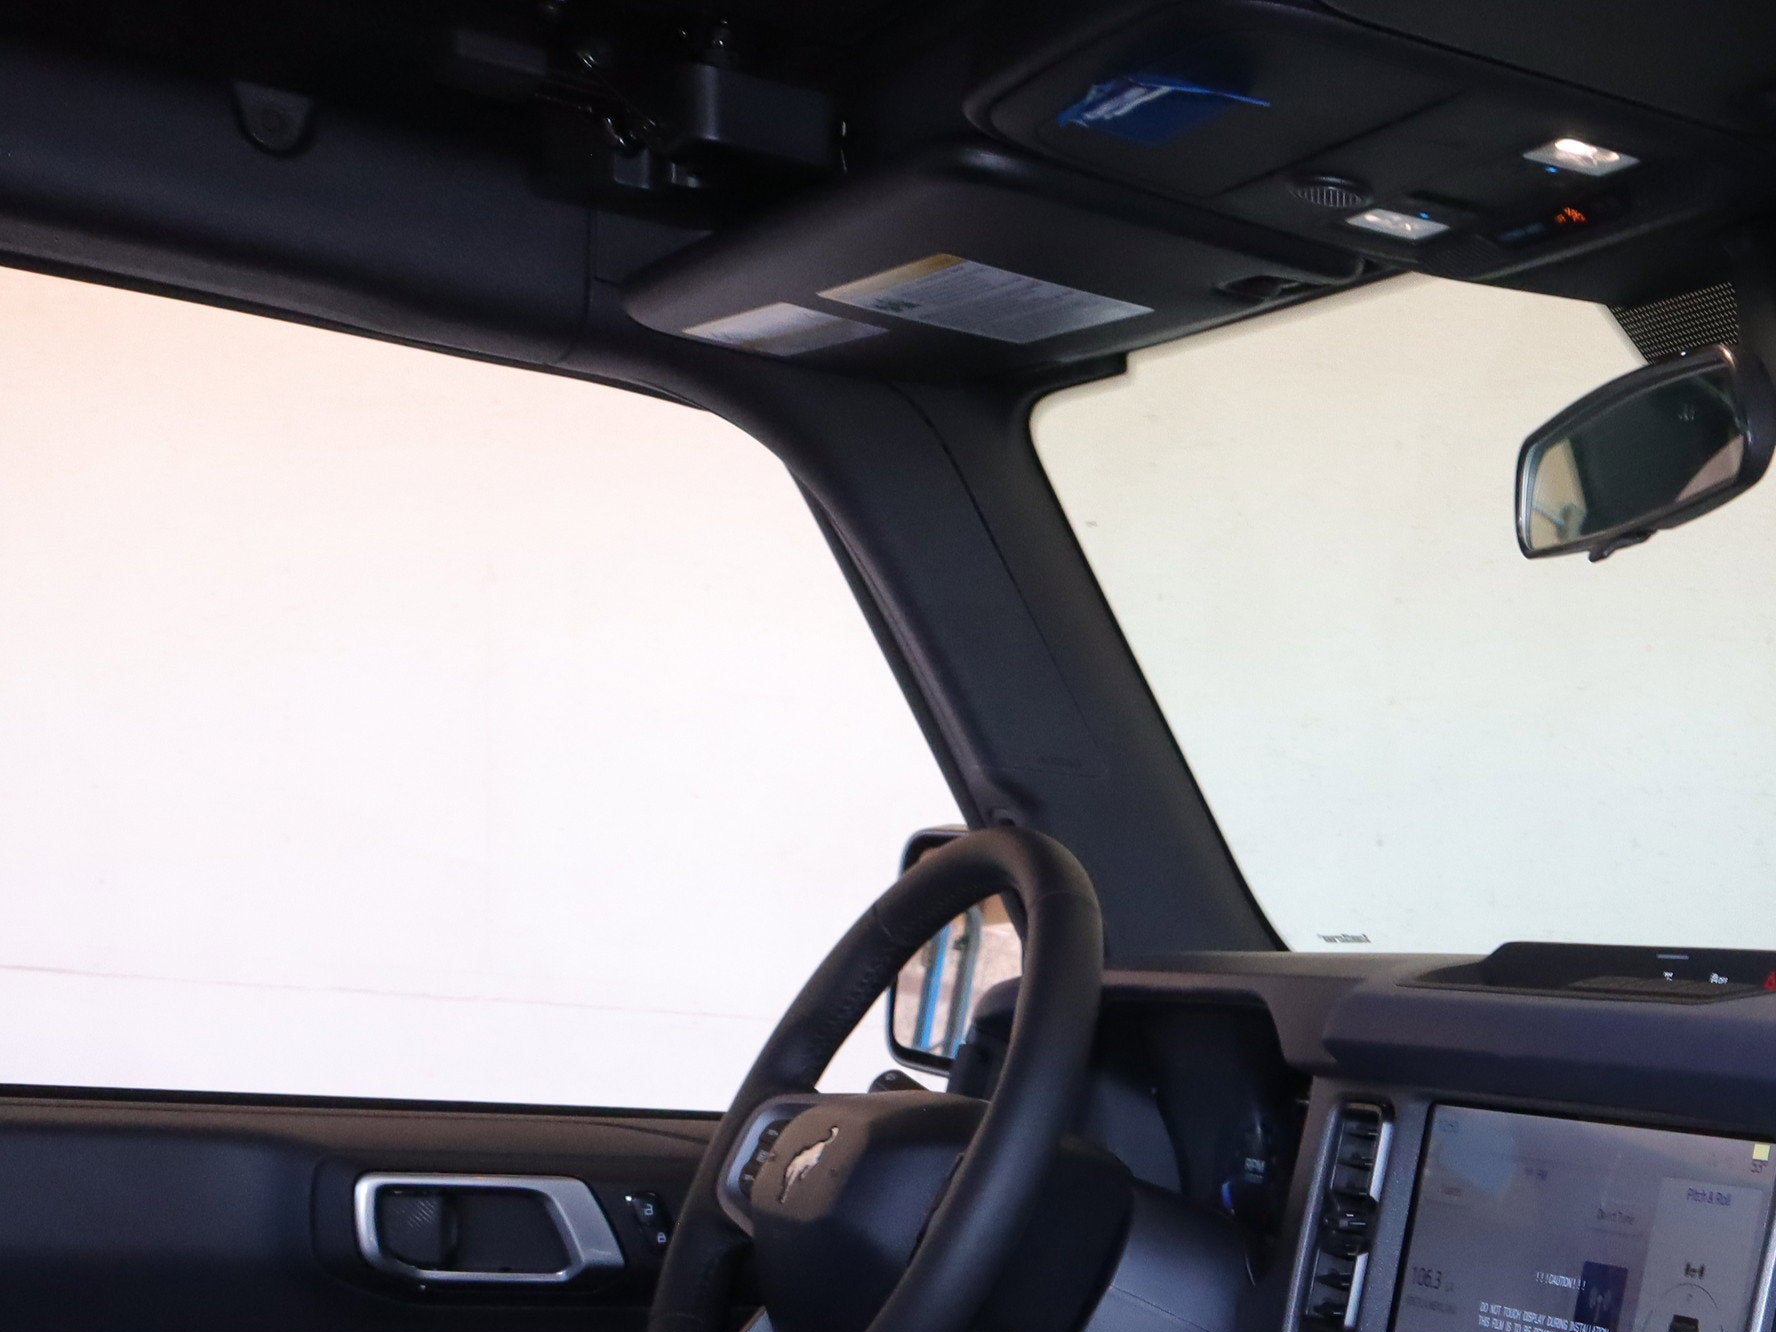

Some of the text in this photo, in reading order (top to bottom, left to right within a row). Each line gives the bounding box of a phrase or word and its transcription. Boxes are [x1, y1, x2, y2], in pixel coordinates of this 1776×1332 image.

[1412, 1266, 1442, 1290] 106.3
[1478, 1315, 1490, 1328] THIS
[1492, 1318, 1504, 1331] FILM
[1505, 1322, 1512, 1332] IS
[1480, 1301, 1489, 1312] DO
[1491, 1304, 1502, 1316] NOT
[1504, 1306, 1521, 1320] TOUCH
[1523, 1310, 1546, 1326] DISPLAY
[1547, 1315, 1568, 1331] DURING
